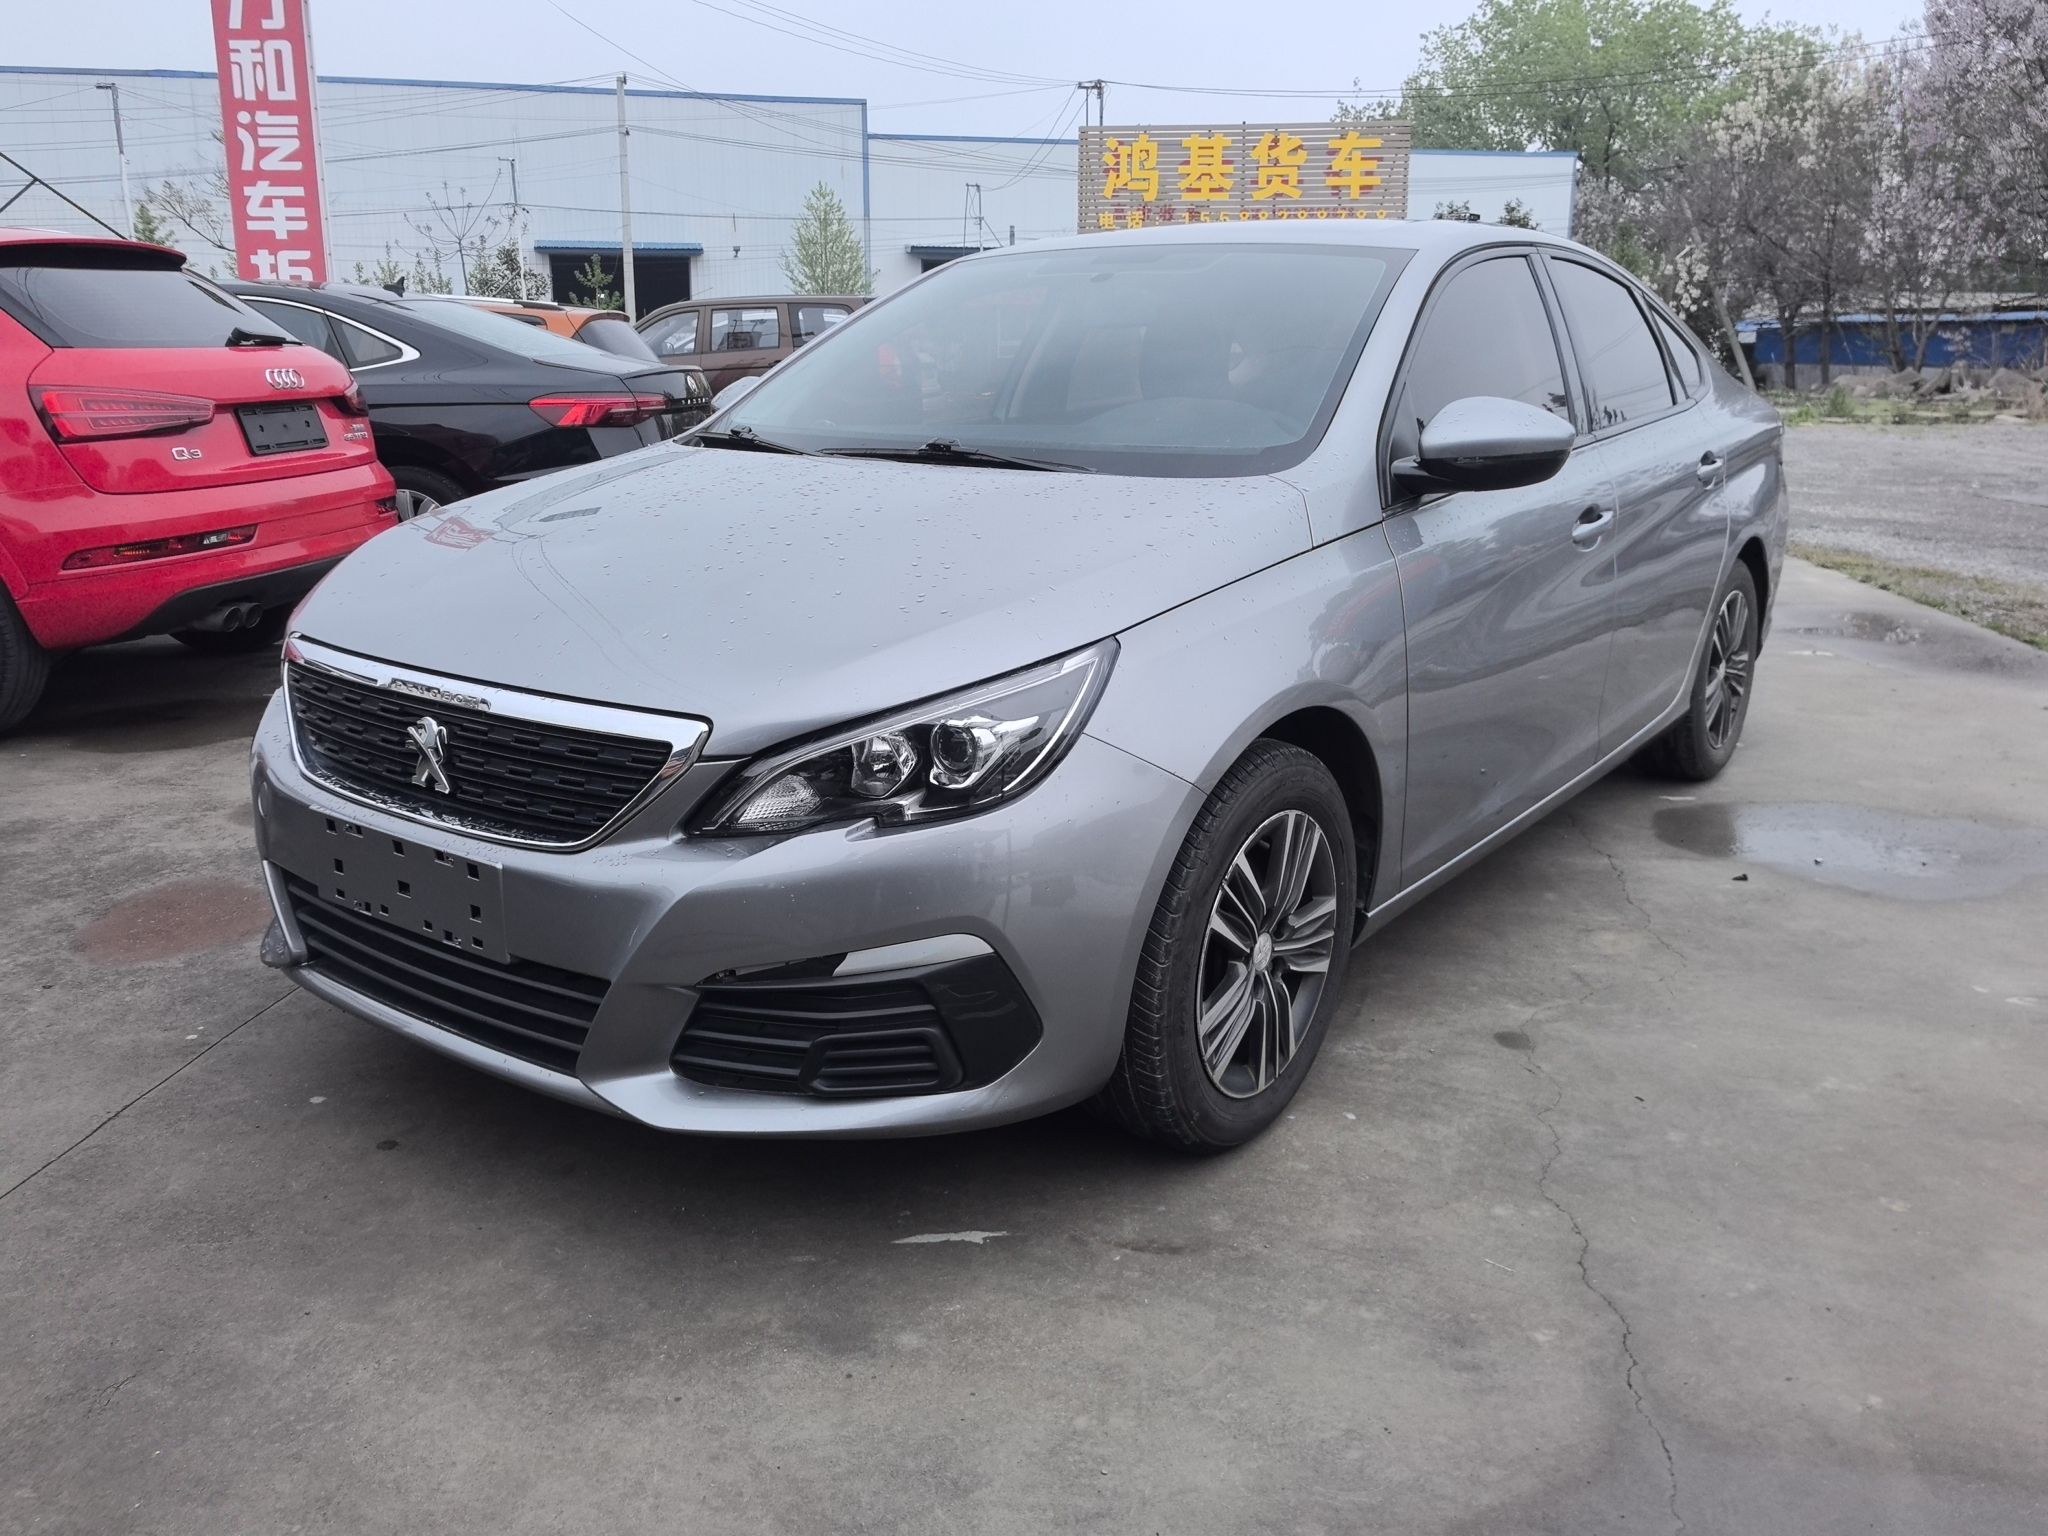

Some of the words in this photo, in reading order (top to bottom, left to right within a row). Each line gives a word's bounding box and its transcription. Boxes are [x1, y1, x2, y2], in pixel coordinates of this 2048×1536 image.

[1103, 131, 1384, 201] 鸿基货车
[171, 446, 202, 460] Q3
